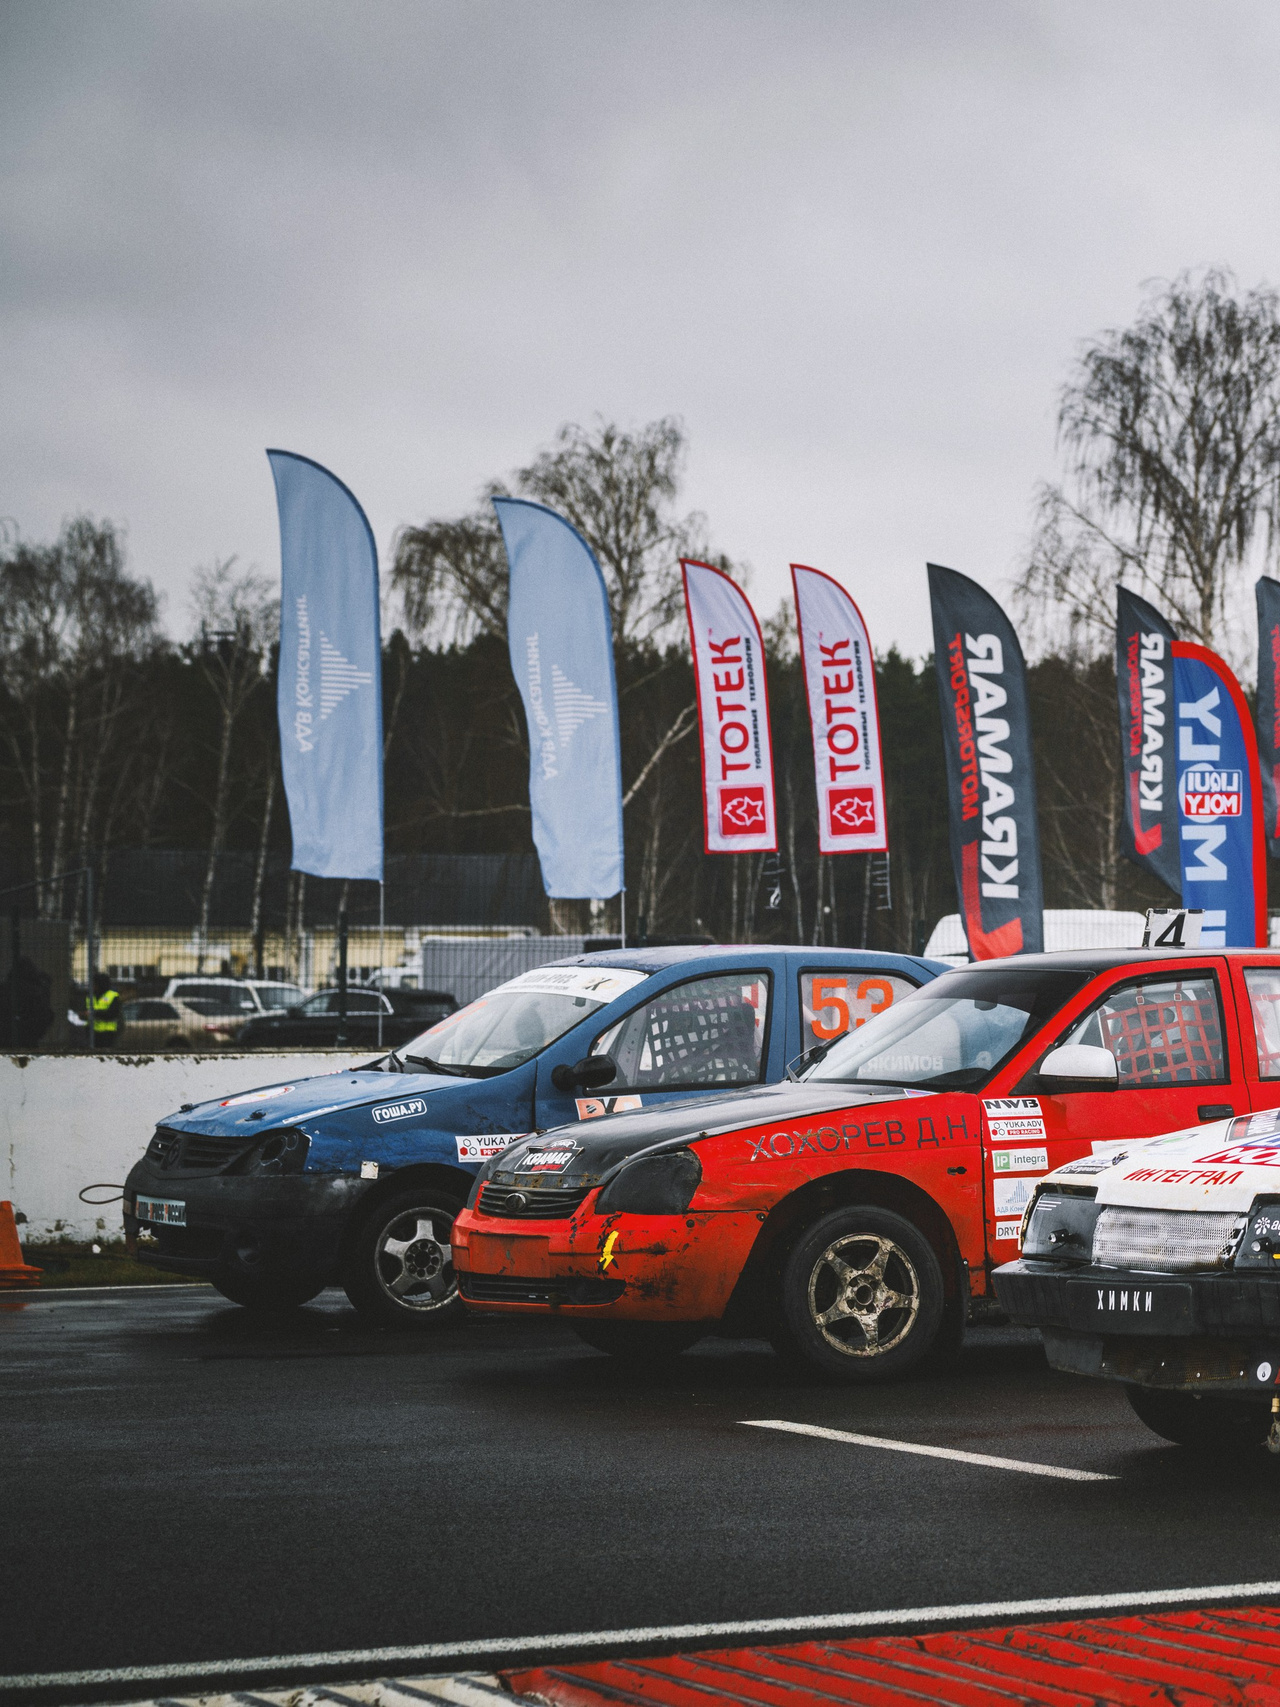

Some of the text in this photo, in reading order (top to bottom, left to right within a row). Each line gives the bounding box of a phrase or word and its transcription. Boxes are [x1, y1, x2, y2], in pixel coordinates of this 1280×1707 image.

[1154, 913, 1186, 947] 4
[810, 977, 894, 1040] 53
[375, 1101, 423, 1121] ГОША.РУ
[983, 1099, 1039, 1110] NWB
[1003, 1120, 1042, 1129] YUKA ADV
[476, 1137, 505, 1147] YUKA
[744, 1115, 978, 1161] ХОХОРЕВ Д.Н.
[1014, 1154, 1046, 1166] integra
[1123, 1168, 1244, 1186] ИНТЕГРАЛ
[1097, 1289, 1152, 1312] ХИМКИ
